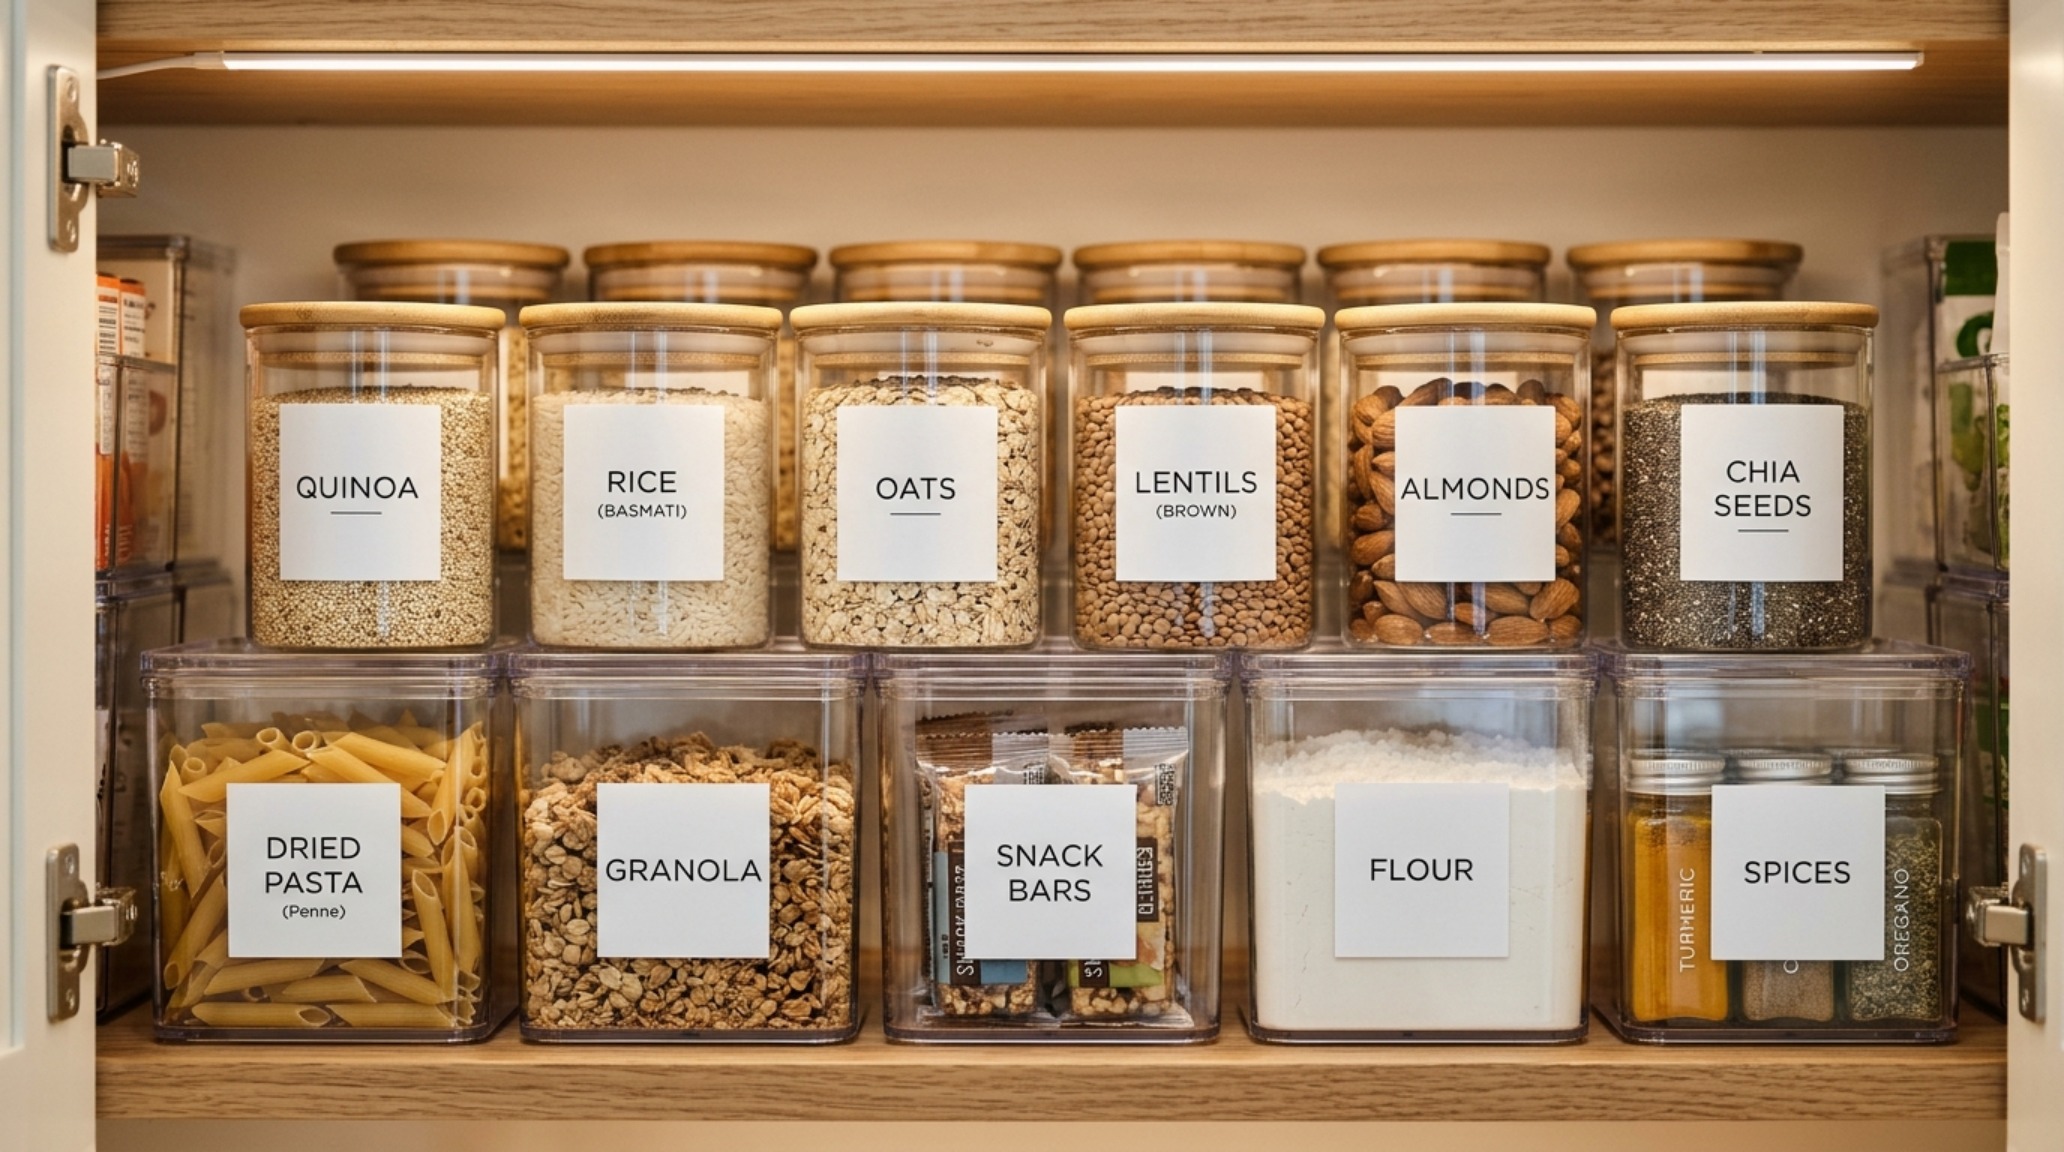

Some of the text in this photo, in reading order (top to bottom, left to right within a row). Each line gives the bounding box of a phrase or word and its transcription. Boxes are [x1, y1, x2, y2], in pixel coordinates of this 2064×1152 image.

[608, 470, 677, 494] RICE
[1136, 470, 1258, 494] LENTILS
[1726, 459, 1801, 484] CHIA
[296, 475, 419, 502] QUINOA
[875, 476, 956, 501] OATS
[1400, 477, 1550, 501] ALMONDS
[597, 502, 688, 521] (BASMATI)
[1155, 502, 1238, 521] (BROWN)
[1714, 494, 1812, 518] SEEDS
[266, 836, 361, 860] DRIED
[997, 843, 1104, 868] SNACK
[605, 858, 763, 883] GRANOLA
[1370, 857, 1474, 882] FLOUR
[1743, 860, 1851, 885] SPICES
[265, 870, 364, 895] PASTA
[1009, 878, 1092, 903] BARS
[282, 903, 347, 921] (Penne)
[1679, 868, 1696, 973] TURMERIC
[1893, 868, 1910, 973] OREGANO
